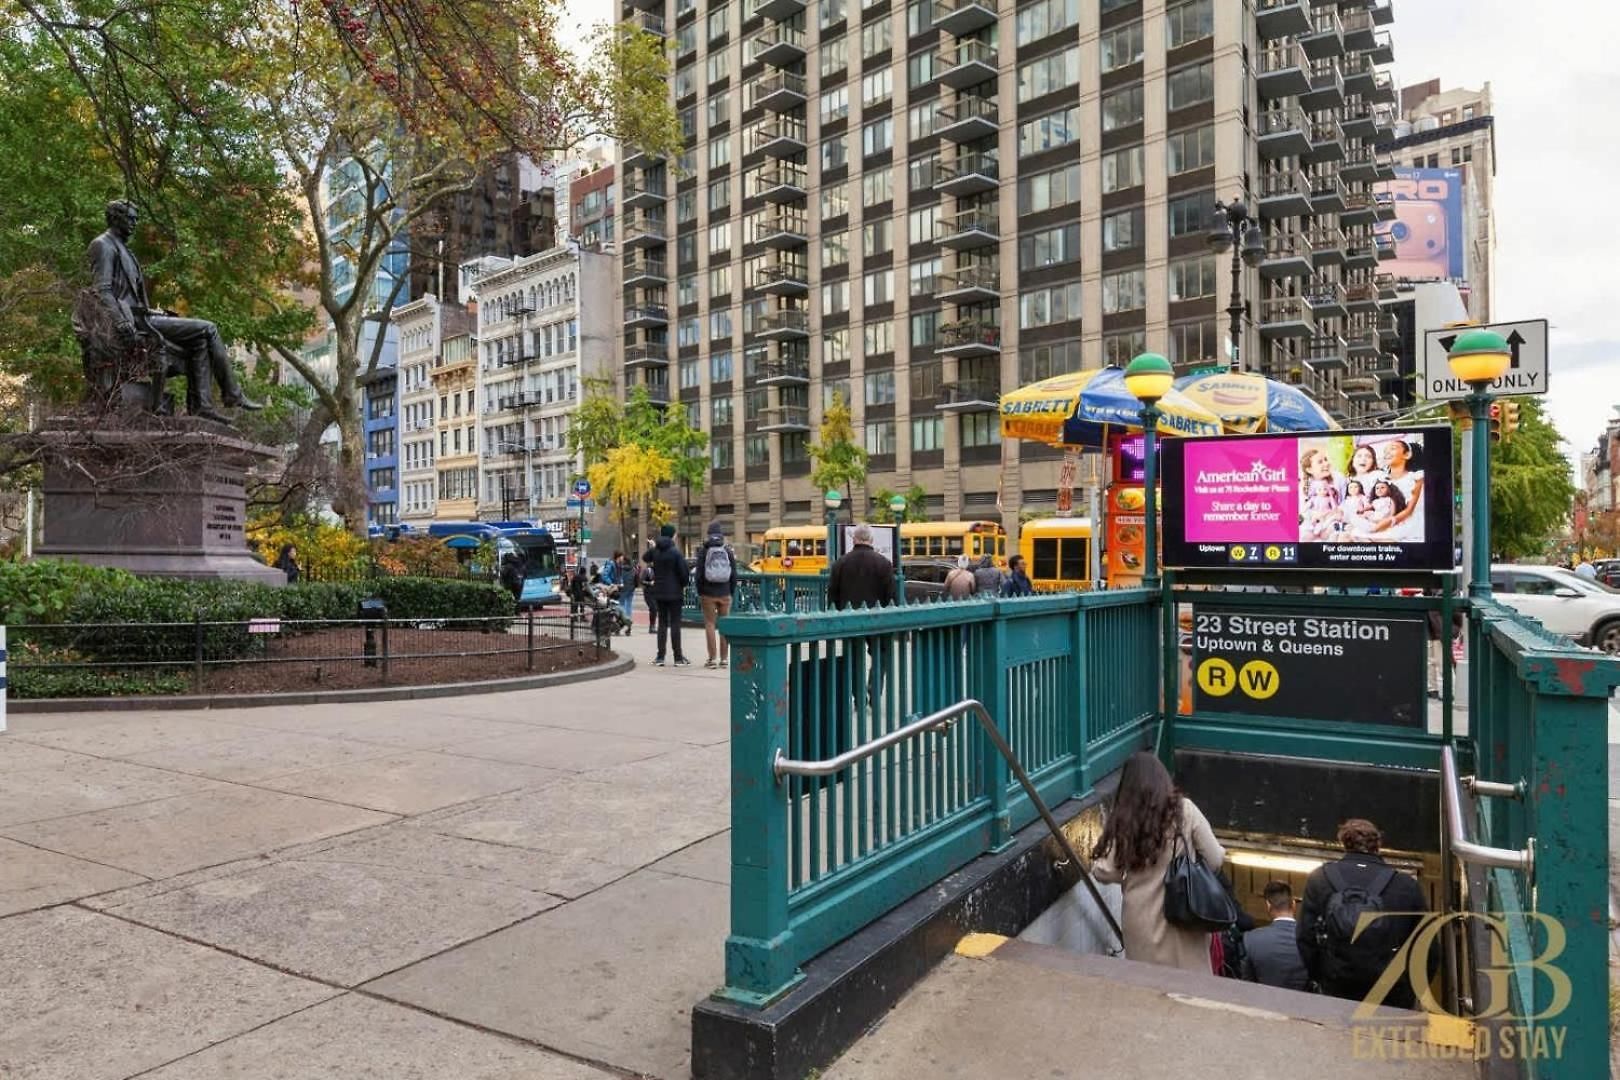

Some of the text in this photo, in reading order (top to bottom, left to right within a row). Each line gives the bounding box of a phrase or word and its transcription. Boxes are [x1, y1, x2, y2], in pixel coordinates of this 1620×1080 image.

[1197, 381, 1260, 392] SABRETT
[1432, 372, 1538, 393] ONL ONLY
[1002, 400, 1072, 415] SABRETT
[1159, 414, 1219, 435] SABRETT
[1197, 467, 1286, 483] American Girl
[1211, 501, 1271, 512] Share a day to
[1203, 511, 1280, 521] remember forever
[1250, 546, 1257, 556] 7
[1282, 546, 1295, 556] 11
[1196, 615, 1389, 641] 23 Street Station
[1197, 635, 1344, 656] Uptown & Queens
